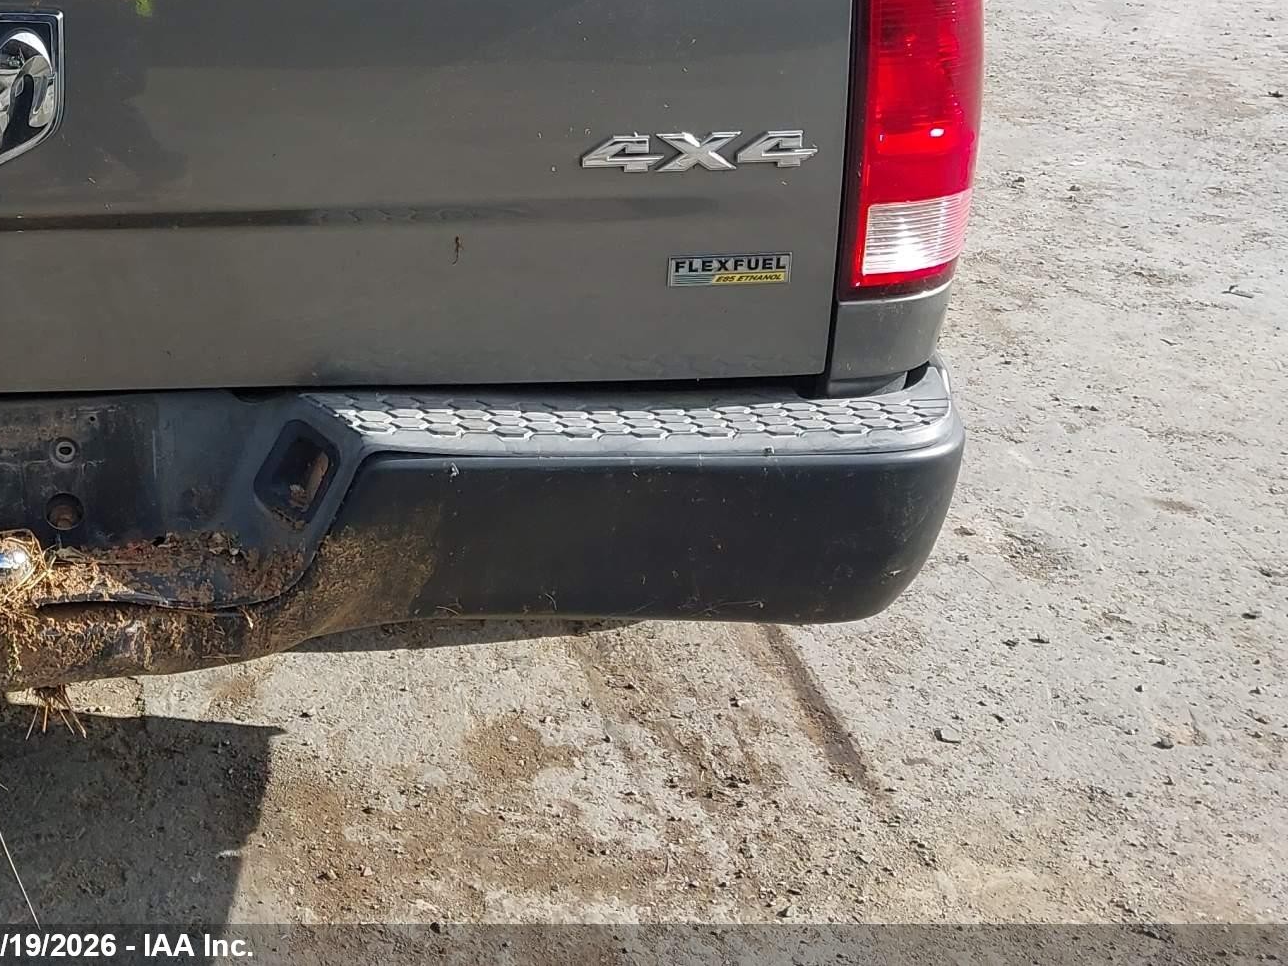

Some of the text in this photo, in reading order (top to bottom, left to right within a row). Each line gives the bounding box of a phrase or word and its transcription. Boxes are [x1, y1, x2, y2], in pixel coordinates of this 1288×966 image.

[674, 257, 787, 273] FLEXFUEL
[715, 273, 783, 283] E85 ETHANOL
